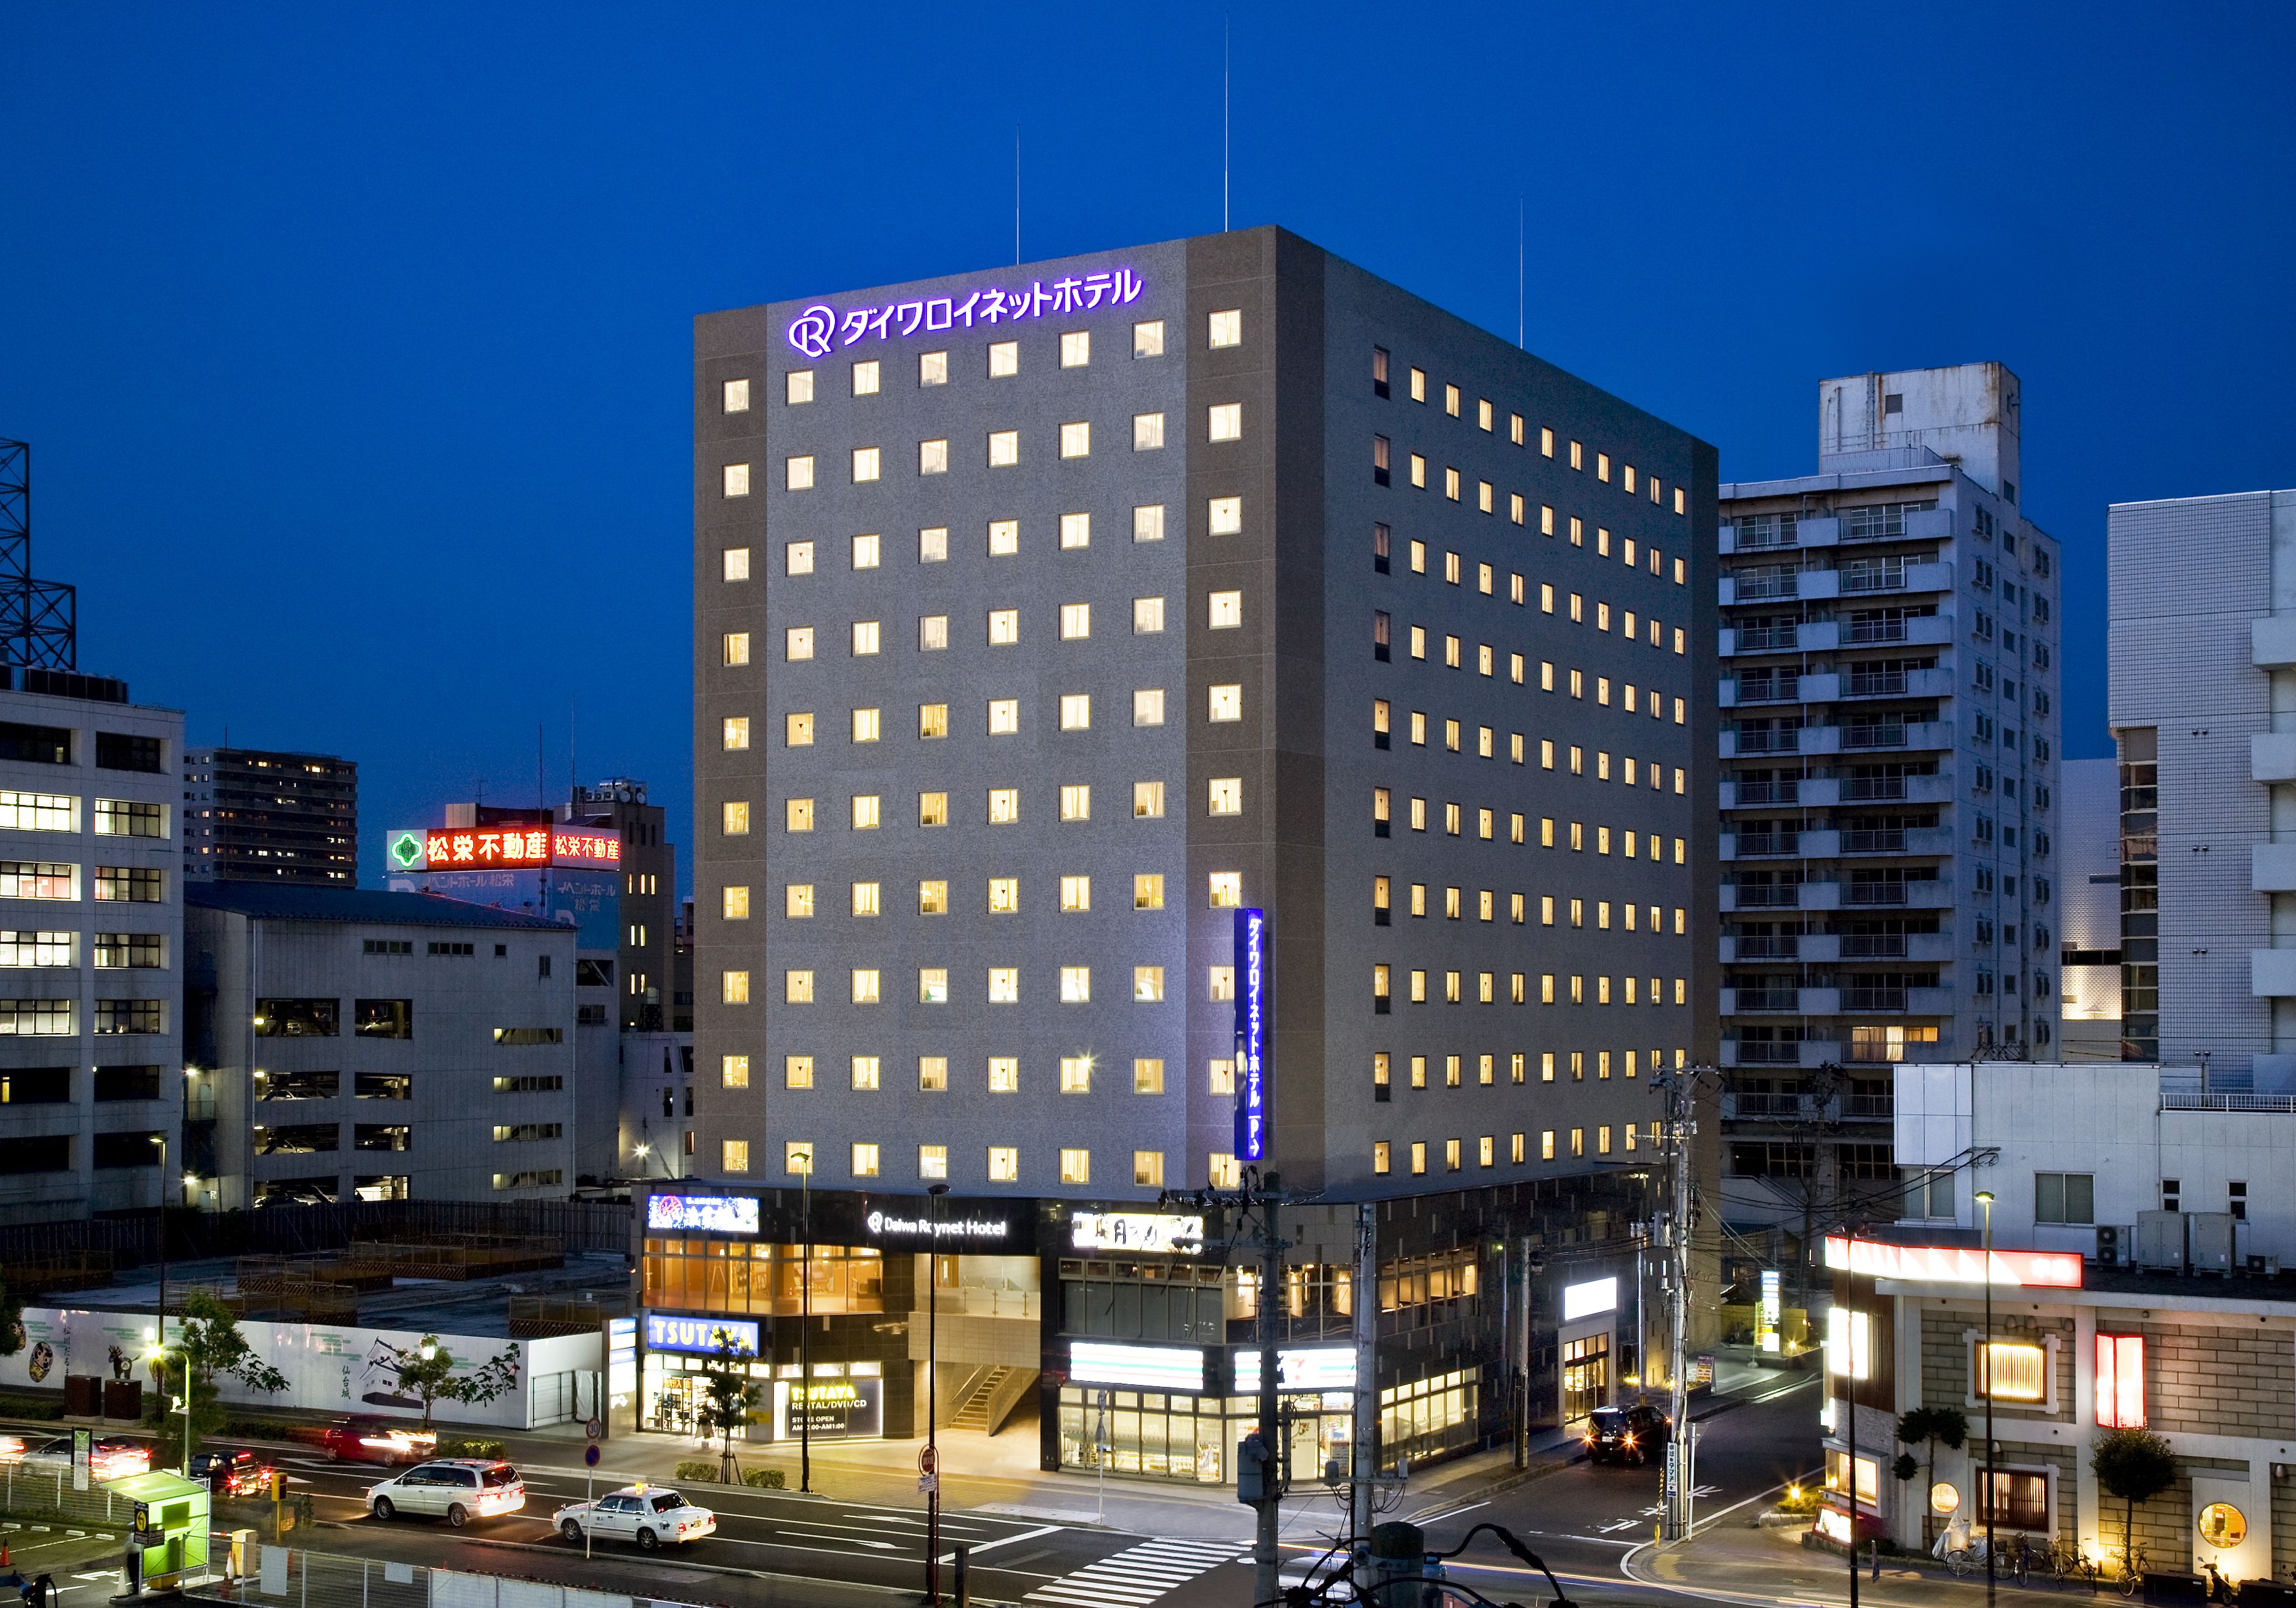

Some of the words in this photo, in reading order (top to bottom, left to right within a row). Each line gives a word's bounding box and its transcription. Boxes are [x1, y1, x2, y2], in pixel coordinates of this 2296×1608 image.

[841, 269, 1142, 345] ダイワロイネットホテル
[427, 832, 547, 862] 松栄不動産
[555, 834, 619, 860] 松栄不動産
[1249, 918, 1262, 1108] ダイワロイネットホテル
[885, 1217, 917, 1233] Daiwa
[967, 1220, 1006, 1235] Hotel
[654, 1320, 754, 1350] TSUTAYA
[342, 1365, 350, 1399] 仙台城
[792, 1399, 867, 1410] RETAL/DVD/CD
[590, 1423, 598, 1434] 30
